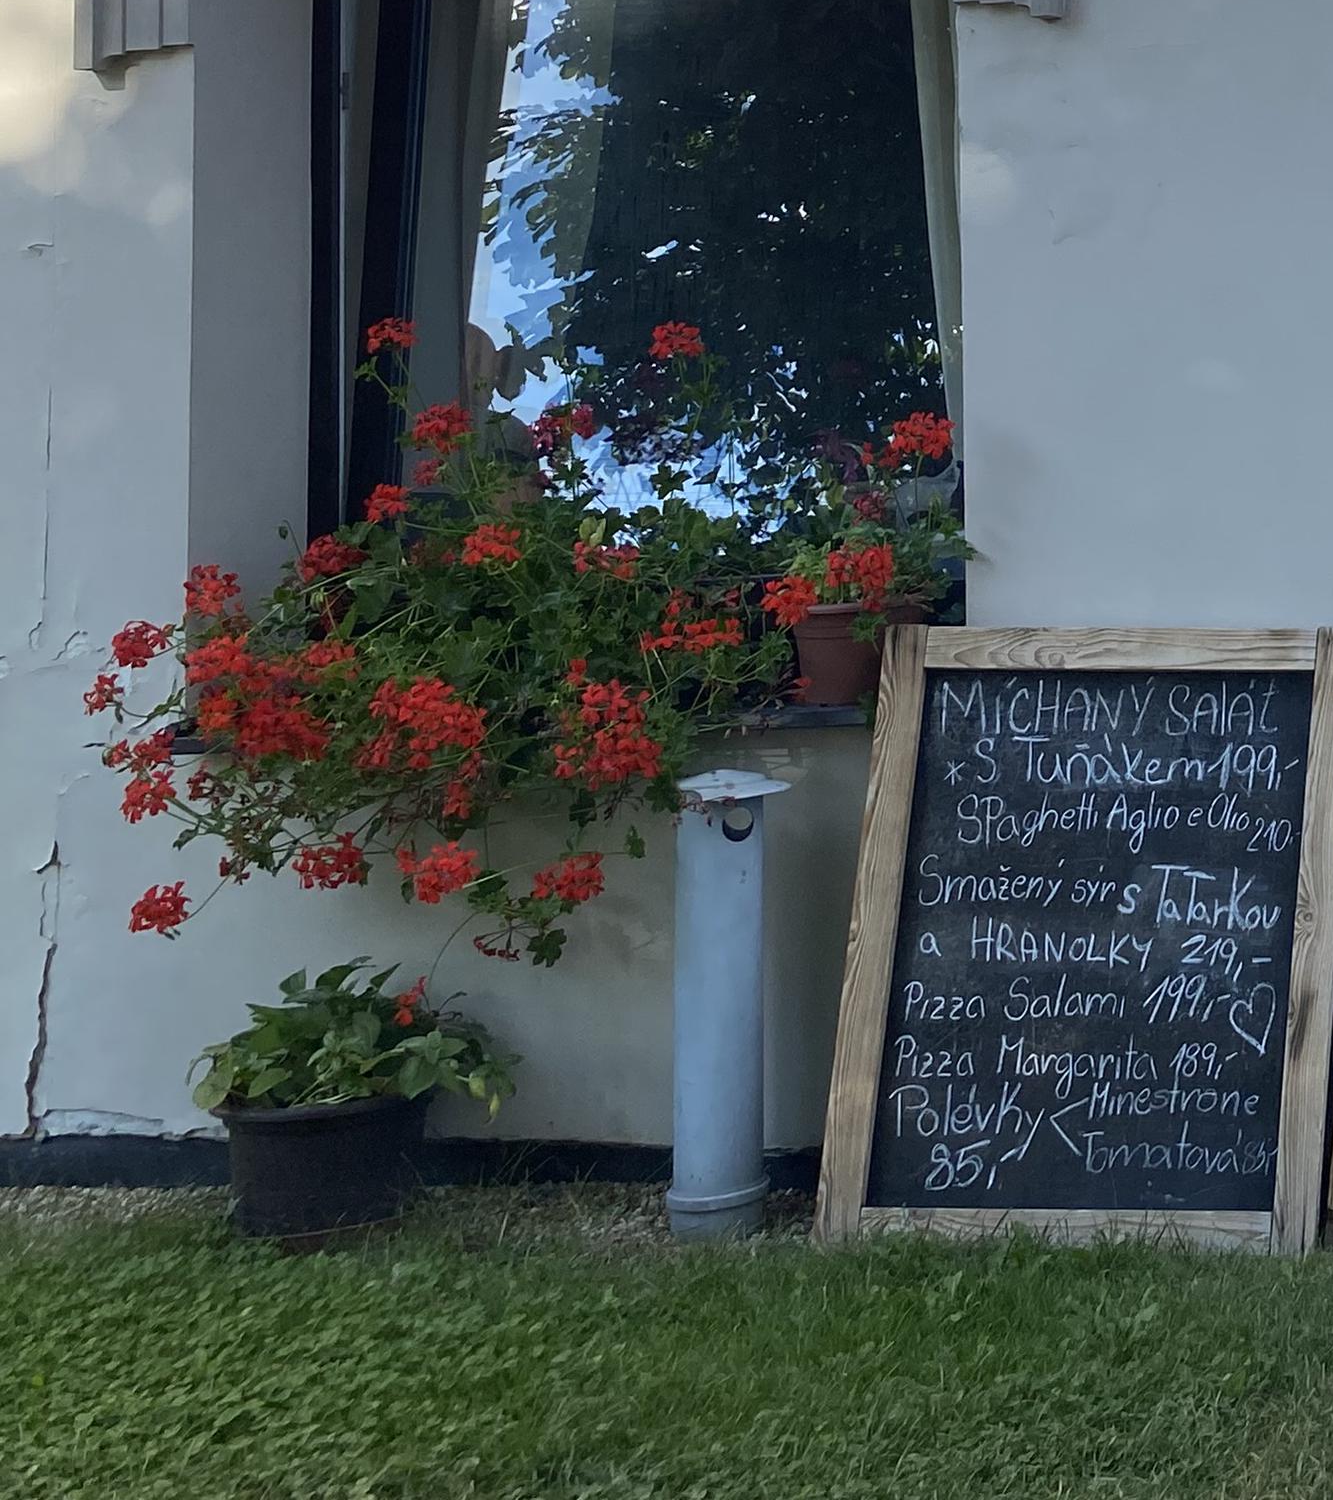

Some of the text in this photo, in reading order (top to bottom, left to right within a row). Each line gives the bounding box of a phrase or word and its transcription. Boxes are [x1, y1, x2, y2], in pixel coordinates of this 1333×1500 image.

[1106, 790, 1180, 855] Aglio
[1187, 805, 1204, 828] e
[1207, 792, 1250, 833] Olio
[918, 854, 1065, 908] Smažený
[1070, 863, 1116, 909] sýr
[919, 931, 942, 958] a
[971, 916, 1154, 972] HRANOLKY
[904, 980, 986, 1022] Pizza
[1004, 973, 1125, 1022] Salami
[893, 1034, 975, 1080] Pizza
[996, 1032, 1159, 1100] Margarita
[1088, 1080, 1260, 1120] Minestrone
[1081, 1120, 1239, 1173] Tomatová
